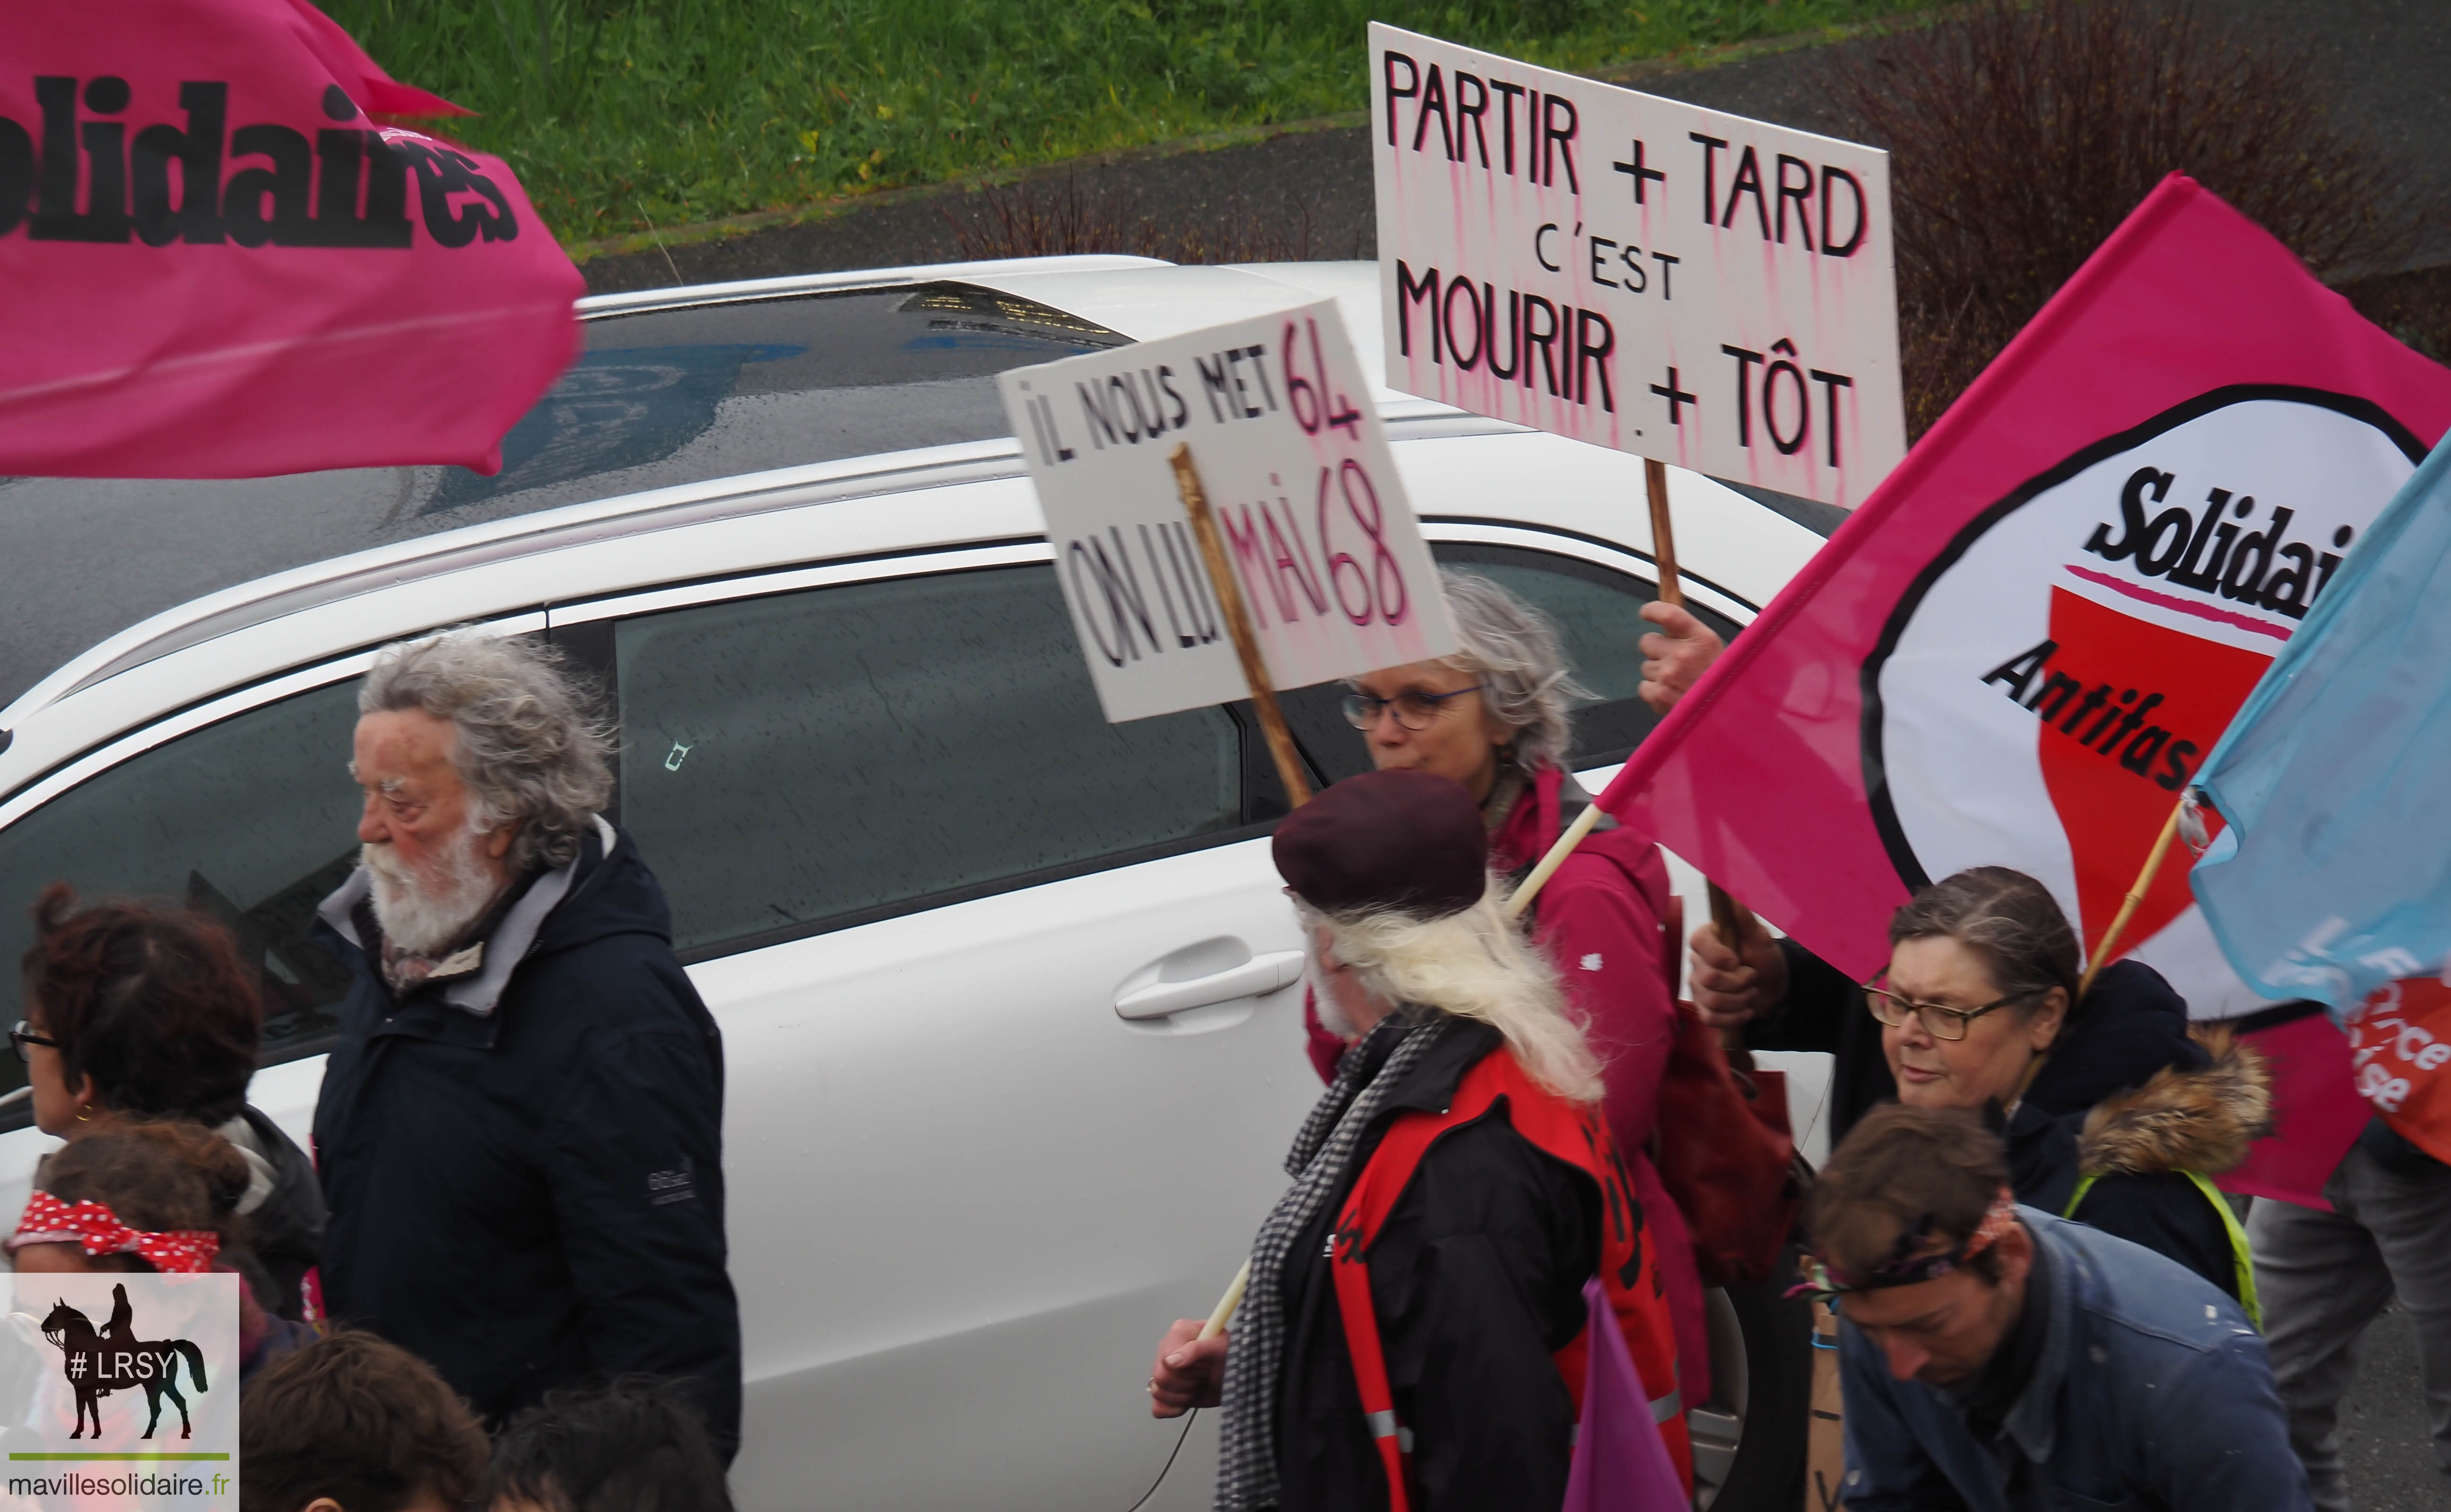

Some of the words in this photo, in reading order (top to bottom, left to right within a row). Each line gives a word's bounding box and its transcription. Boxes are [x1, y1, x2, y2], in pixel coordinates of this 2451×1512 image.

[1383, 51, 1579, 194] PARTIR
[1688, 131, 1869, 258] TARD
[1396, 258, 1616, 413] MOURIR
[1721, 338, 1852, 468] TÔT
[1536, 221, 1680, 301] C'EST
[1076, 365, 1191, 450] NOUS
[1194, 344, 1279, 424] MET
[1280, 318, 1363, 441] 64
[1068, 525, 1163, 668] ON
[1318, 458, 1409, 626] 68
